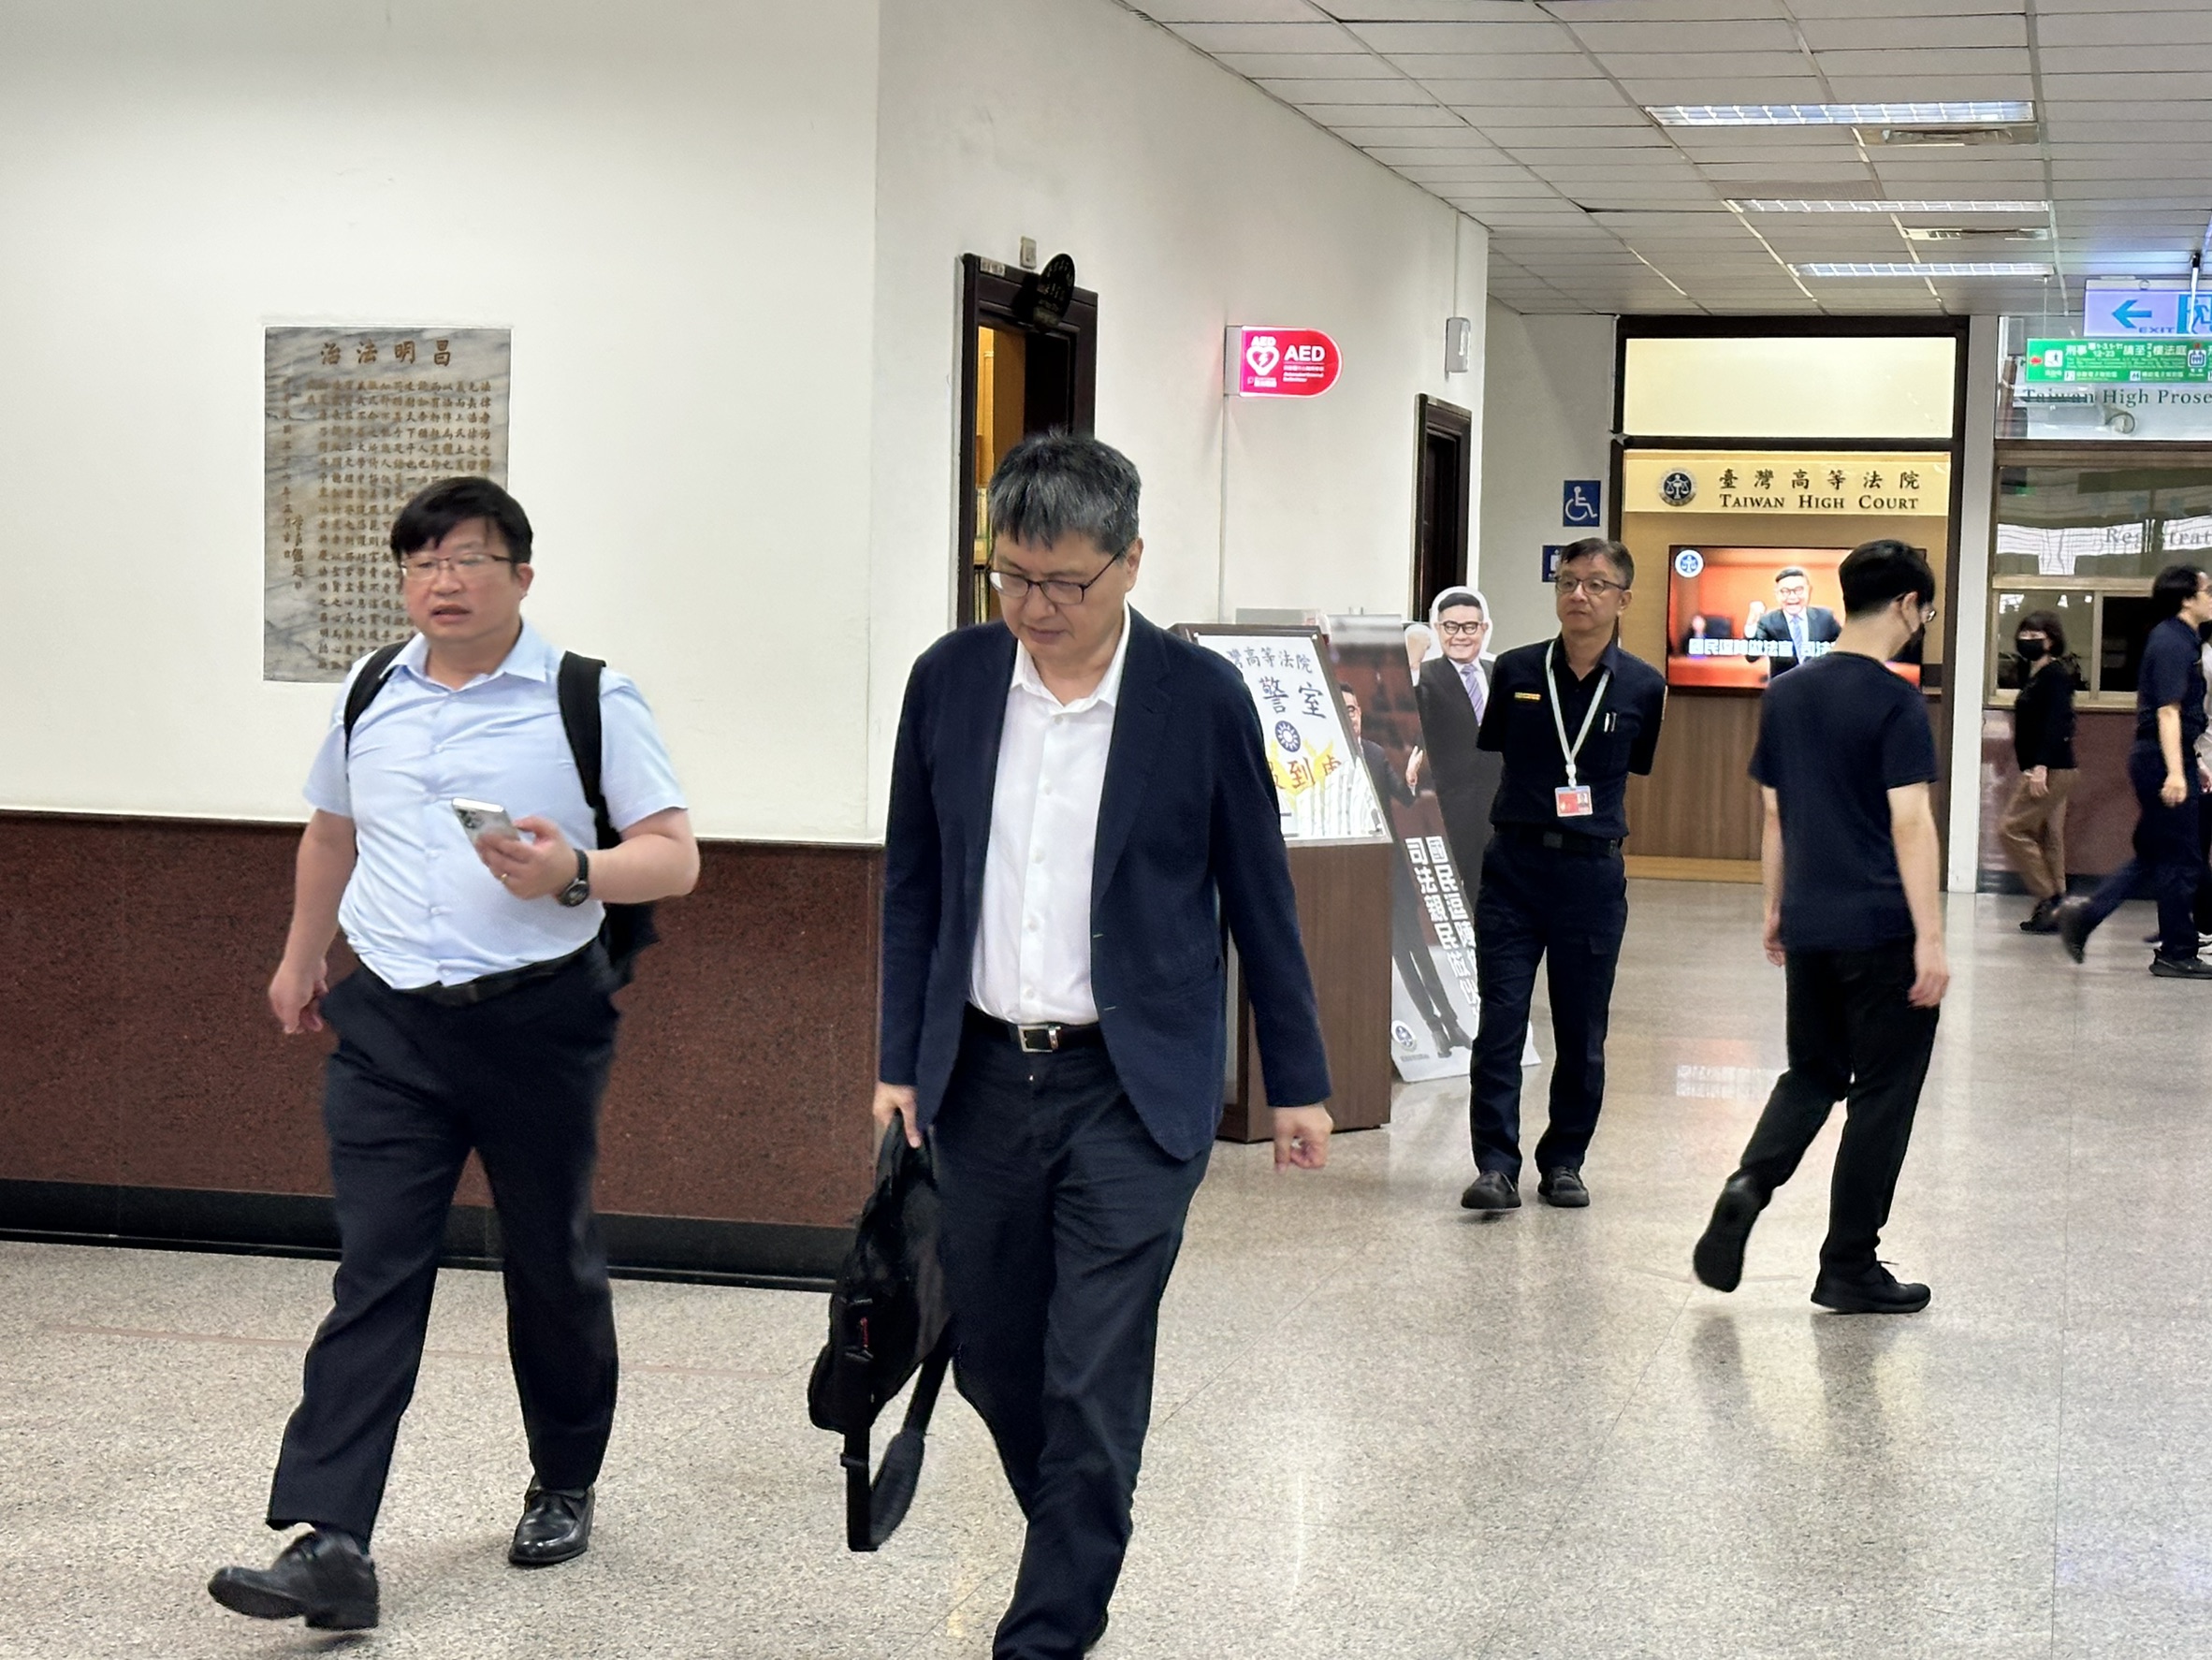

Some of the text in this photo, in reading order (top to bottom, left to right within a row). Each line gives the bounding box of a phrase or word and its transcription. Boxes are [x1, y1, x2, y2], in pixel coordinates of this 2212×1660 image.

[1251, 336, 1276, 347] AED
[1283, 345, 1325, 361] AED
[2103, 389, 2149, 407] High
[1719, 469, 1920, 489] 臺灣高等法院
